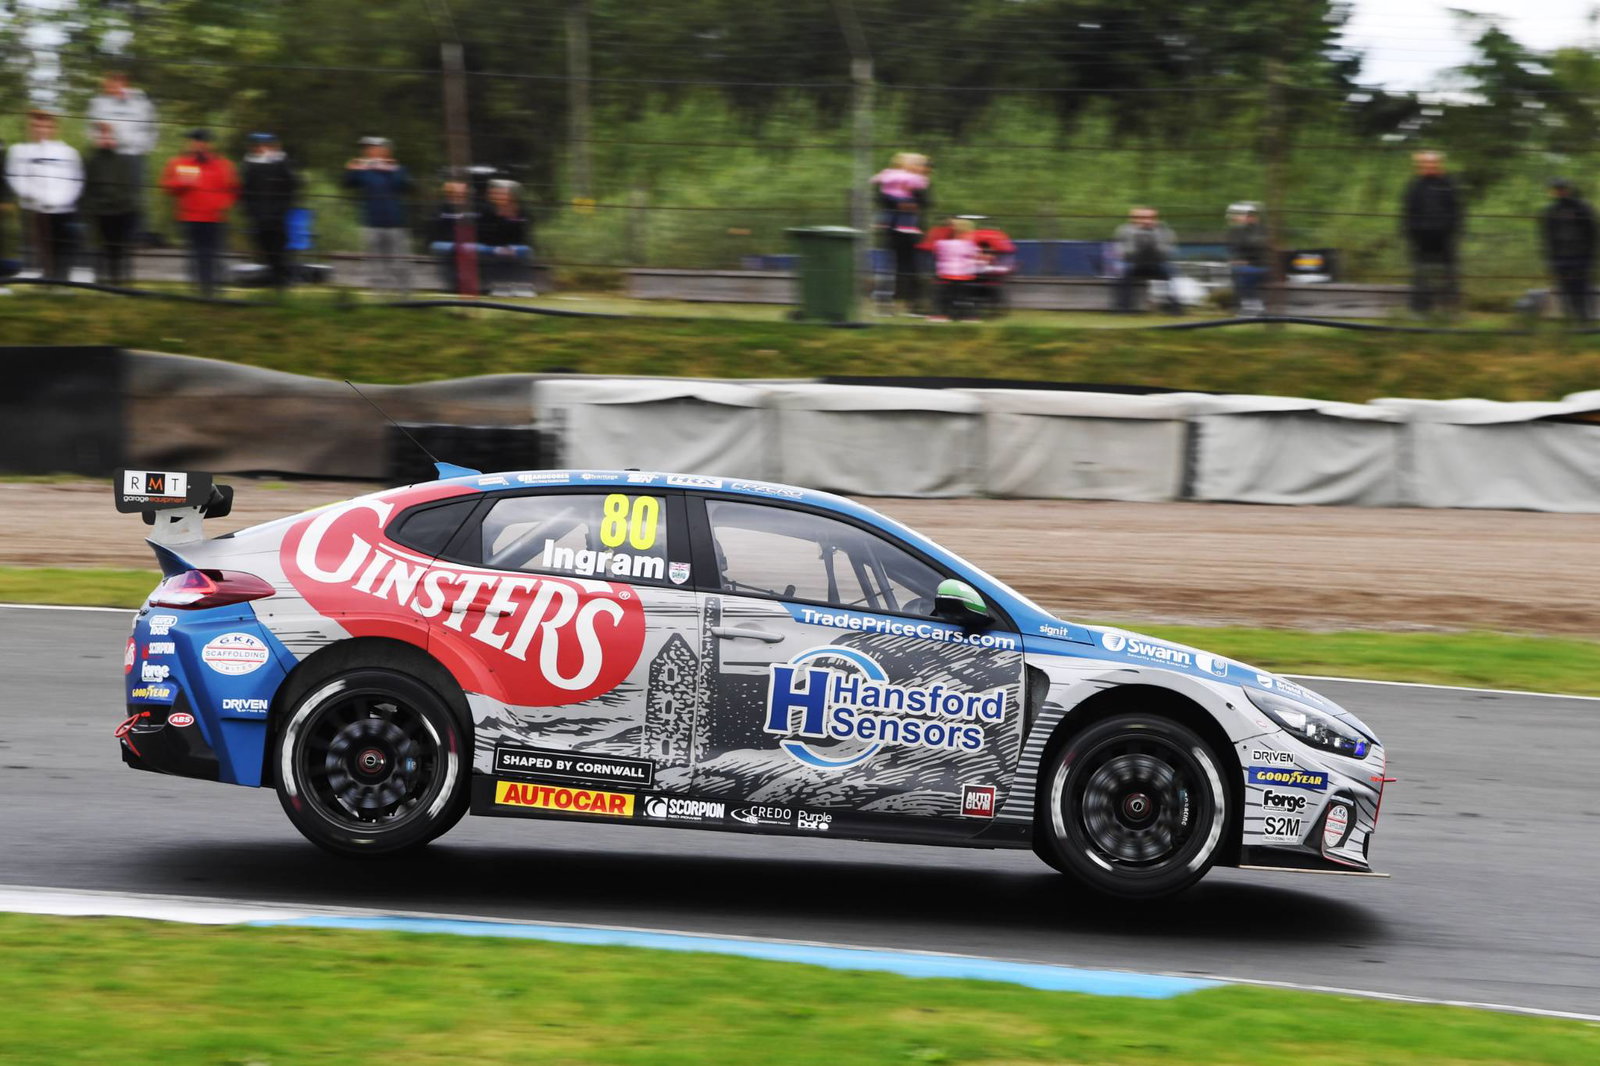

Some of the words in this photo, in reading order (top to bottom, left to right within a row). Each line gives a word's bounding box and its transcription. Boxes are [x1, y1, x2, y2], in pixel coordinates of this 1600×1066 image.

[600, 494, 659, 550] 80
[542, 539, 665, 580] Ingram
[296, 498, 624, 691] GINSTERS
[801, 608, 1015, 650] TradePriceCars.com
[1040, 624, 1069, 636] signit
[219, 636, 255, 646] GKR
[205, 650, 266, 659] SCAFFOLDING
[1127, 638, 1190, 665] Swann
[222, 698, 268, 712] DRIVEN
[767, 667, 830, 735] H
[833, 676, 1004, 719] Hansford
[171, 716, 192, 724] ABS
[830, 707, 982, 750] Sensors
[1253, 750, 1294, 764] DRIVEN
[503, 754, 553, 769] SHAPED
[556, 760, 573, 770] BY
[576, 763, 645, 778] CORNWALL
[1256, 771, 1323, 785] GOODYEAR
[502, 783, 627, 814] AUTOCAR
[966, 792, 991, 801] AUTO
[668, 799, 725, 818] SCORPION
[750, 805, 792, 820] CREDO
[965, 801, 990, 810] GLYM
[797, 820, 818, 829] Dot
[798, 810, 832, 823] Purple
[1264, 816, 1301, 836] S2M
